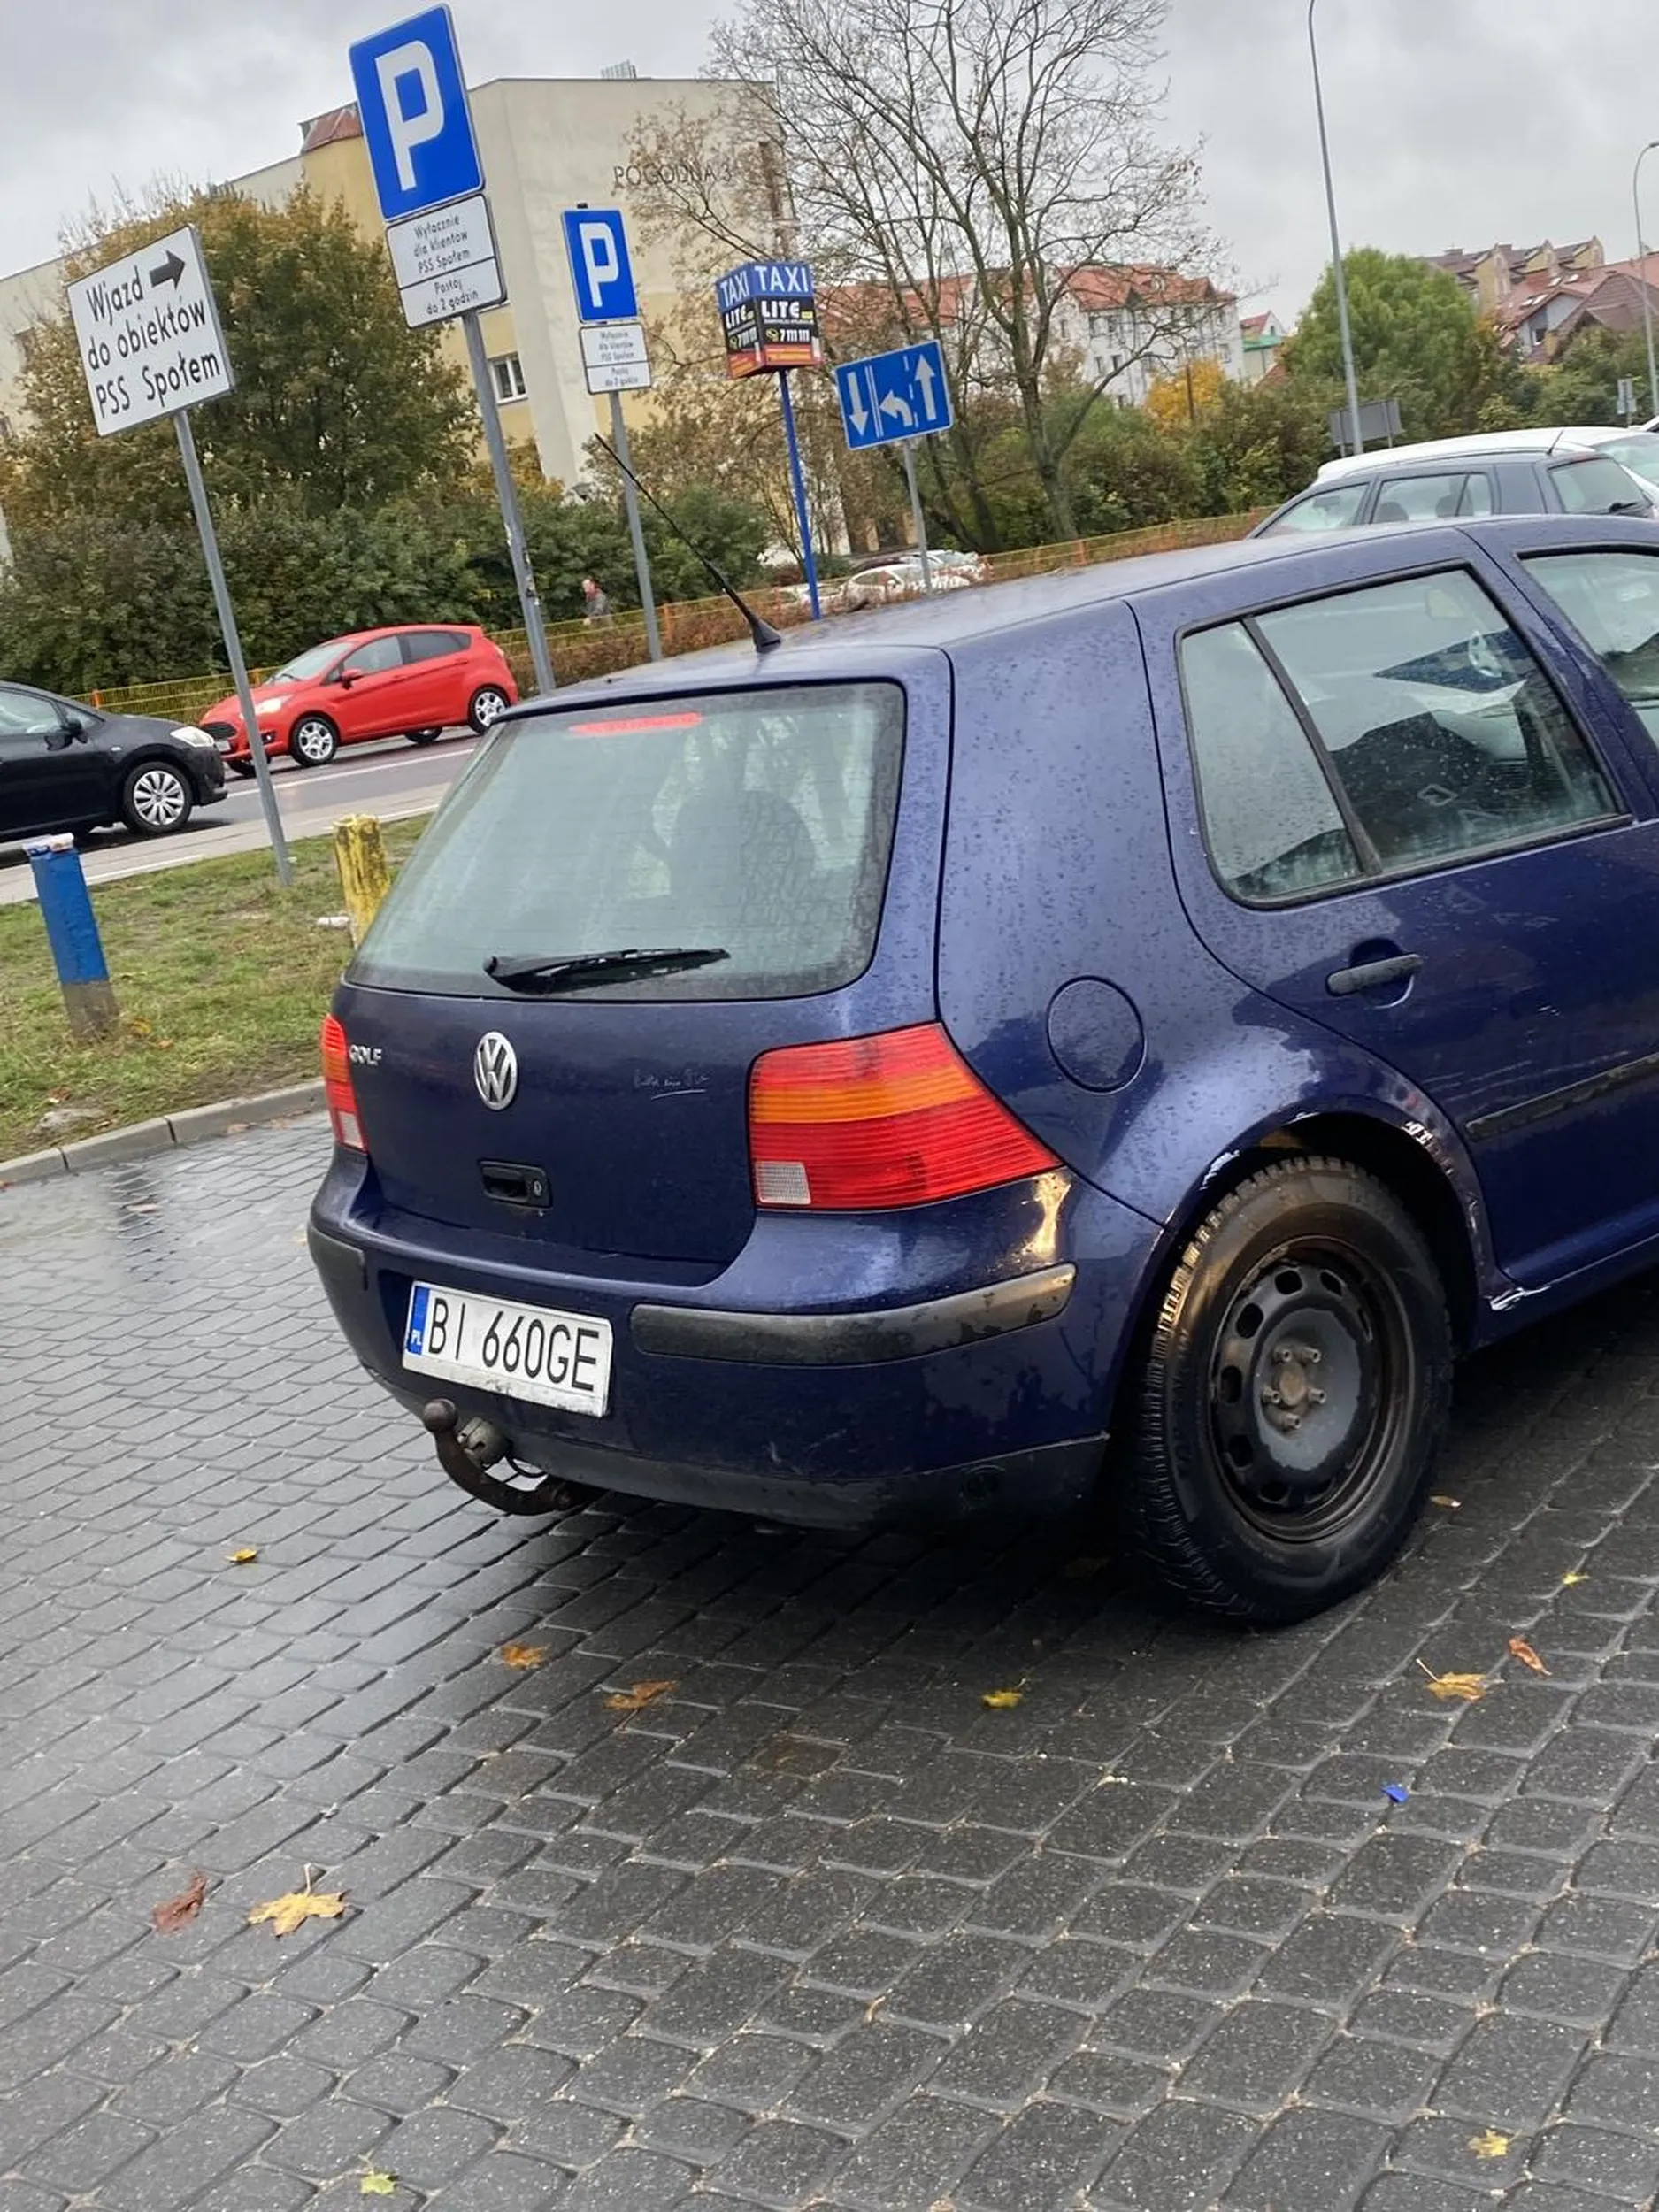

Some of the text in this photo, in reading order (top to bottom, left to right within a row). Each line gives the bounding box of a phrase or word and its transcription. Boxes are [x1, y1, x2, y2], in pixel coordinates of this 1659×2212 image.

[374, 40, 444, 191] P
[86, 265, 144, 326] Wjazd
[579, 223, 619, 307] P
[719, 270, 750, 308] TAXI
[754, 265, 809, 293] TAXI
[88, 295, 206, 371] do obiektów
[426, 301, 438, 315] do
[440, 298, 447, 311] 2
[761, 300, 800, 319] LITE
[96, 351, 220, 419] PSS Społem
[349, 1044, 382, 1065] GOLF
[428, 1297, 600, 1393] BI 660GE
